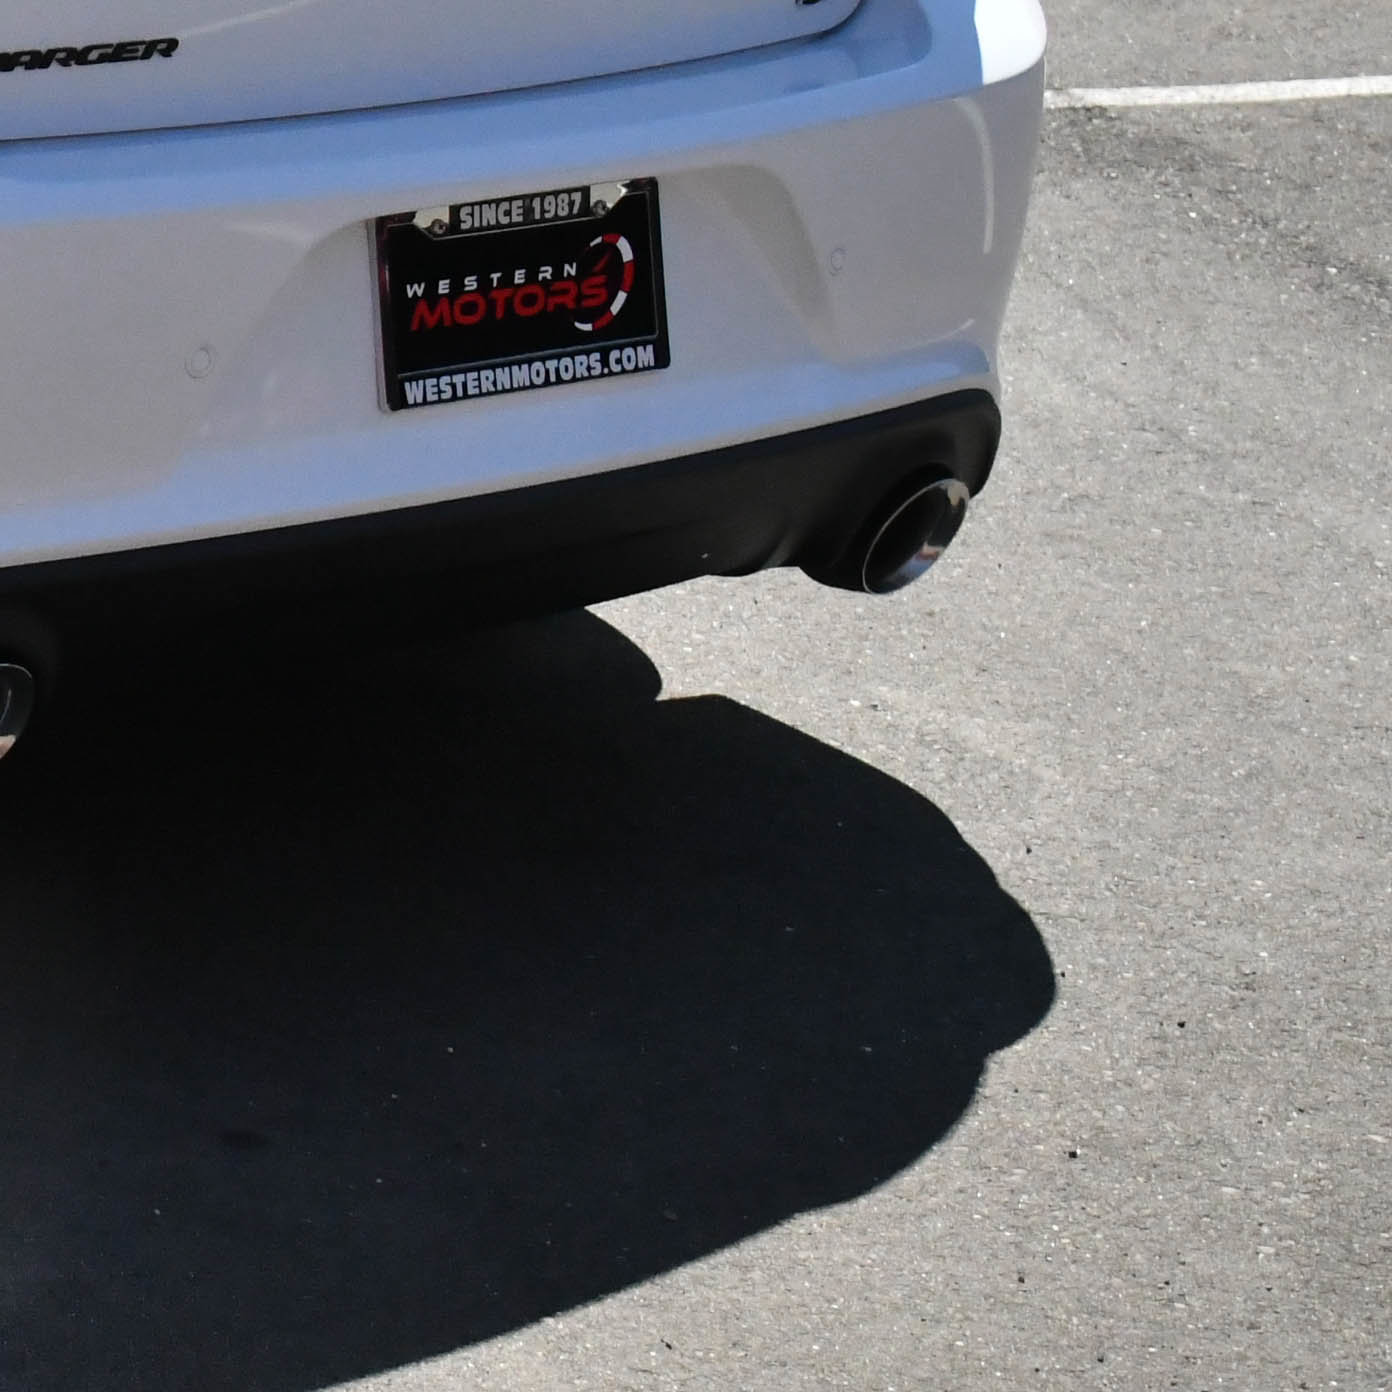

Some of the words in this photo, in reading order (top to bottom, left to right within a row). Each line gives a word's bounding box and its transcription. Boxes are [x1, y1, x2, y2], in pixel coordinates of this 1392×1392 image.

[459, 199, 523, 230] SINCE
[532, 191, 582, 219] 1987
[406, 262, 577, 298] WESTERN
[410, 274, 609, 331] MOTORS
[404, 344, 655, 405] WESTERNMOTORS.COM
